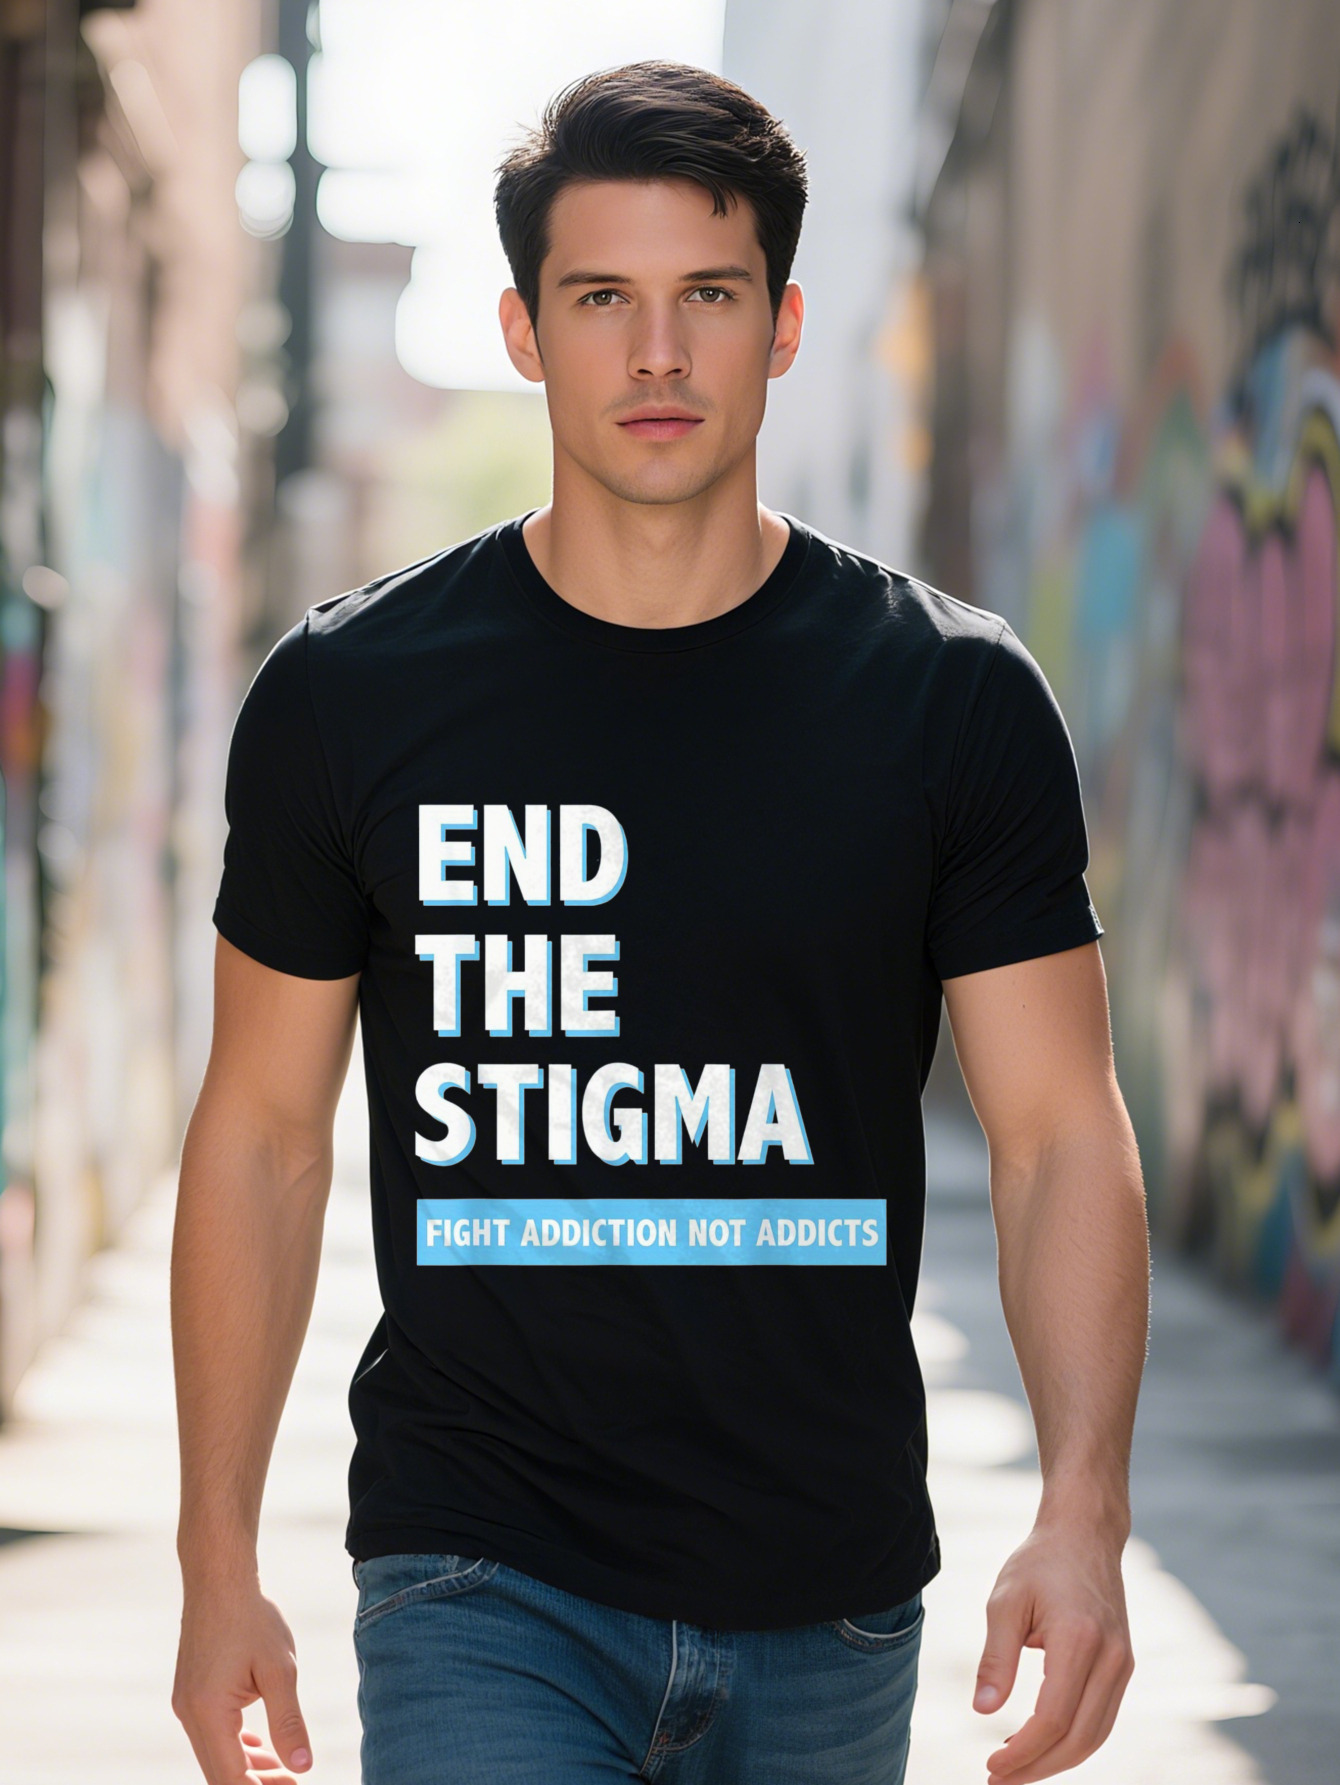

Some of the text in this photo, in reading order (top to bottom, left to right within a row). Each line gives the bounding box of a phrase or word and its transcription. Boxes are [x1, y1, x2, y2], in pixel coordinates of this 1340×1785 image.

[418, 804, 629, 906] END
[415, 934, 621, 1037] THE
[415, 1062, 815, 1166] STIGMA
[426, 1218, 879, 1247] FIGHT ADDICTION NOT ADDICTS
